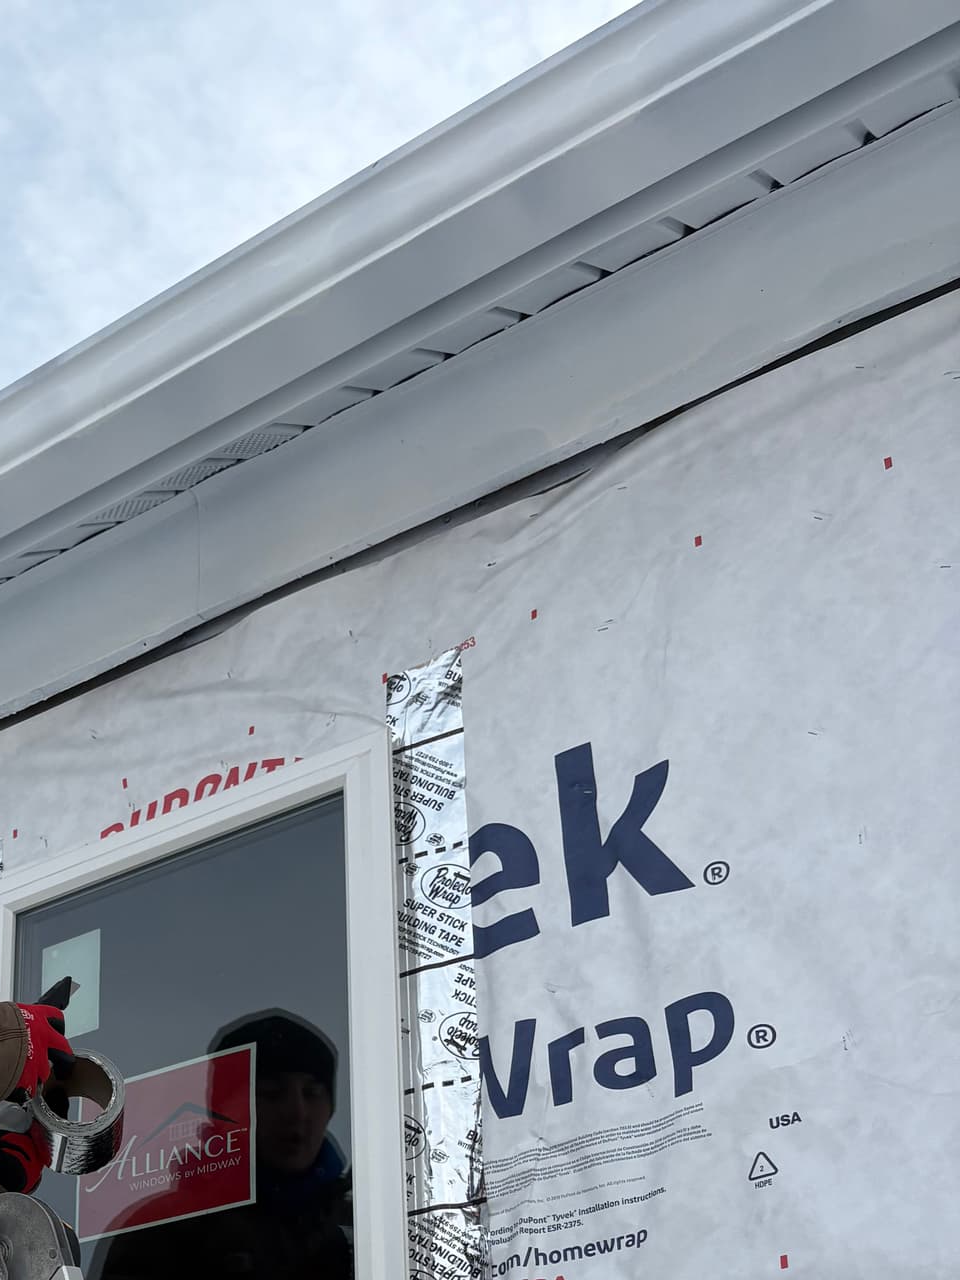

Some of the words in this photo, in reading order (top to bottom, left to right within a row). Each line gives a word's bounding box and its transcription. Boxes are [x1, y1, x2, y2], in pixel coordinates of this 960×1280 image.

[410, 775, 456, 800] BUILDING
[410, 791, 444, 812] SUPER
[403, 898, 437, 918] SUPER
[437, 912, 468, 932] STICK
[437, 929, 465, 947] TAPE
[768, 1111, 802, 1130] USA
[129, 1171, 182, 1192] WINDOWS
[197, 1156, 242, 1176] MIDWAY
[754, 1178, 773, 1190] HDPE
[490, 1225, 514, 1238] ording
[578, 1199, 620, 1216] installation
[621, 1186, 667, 1206] instructions.
[429, 1242, 481, 1279] BUILDING
